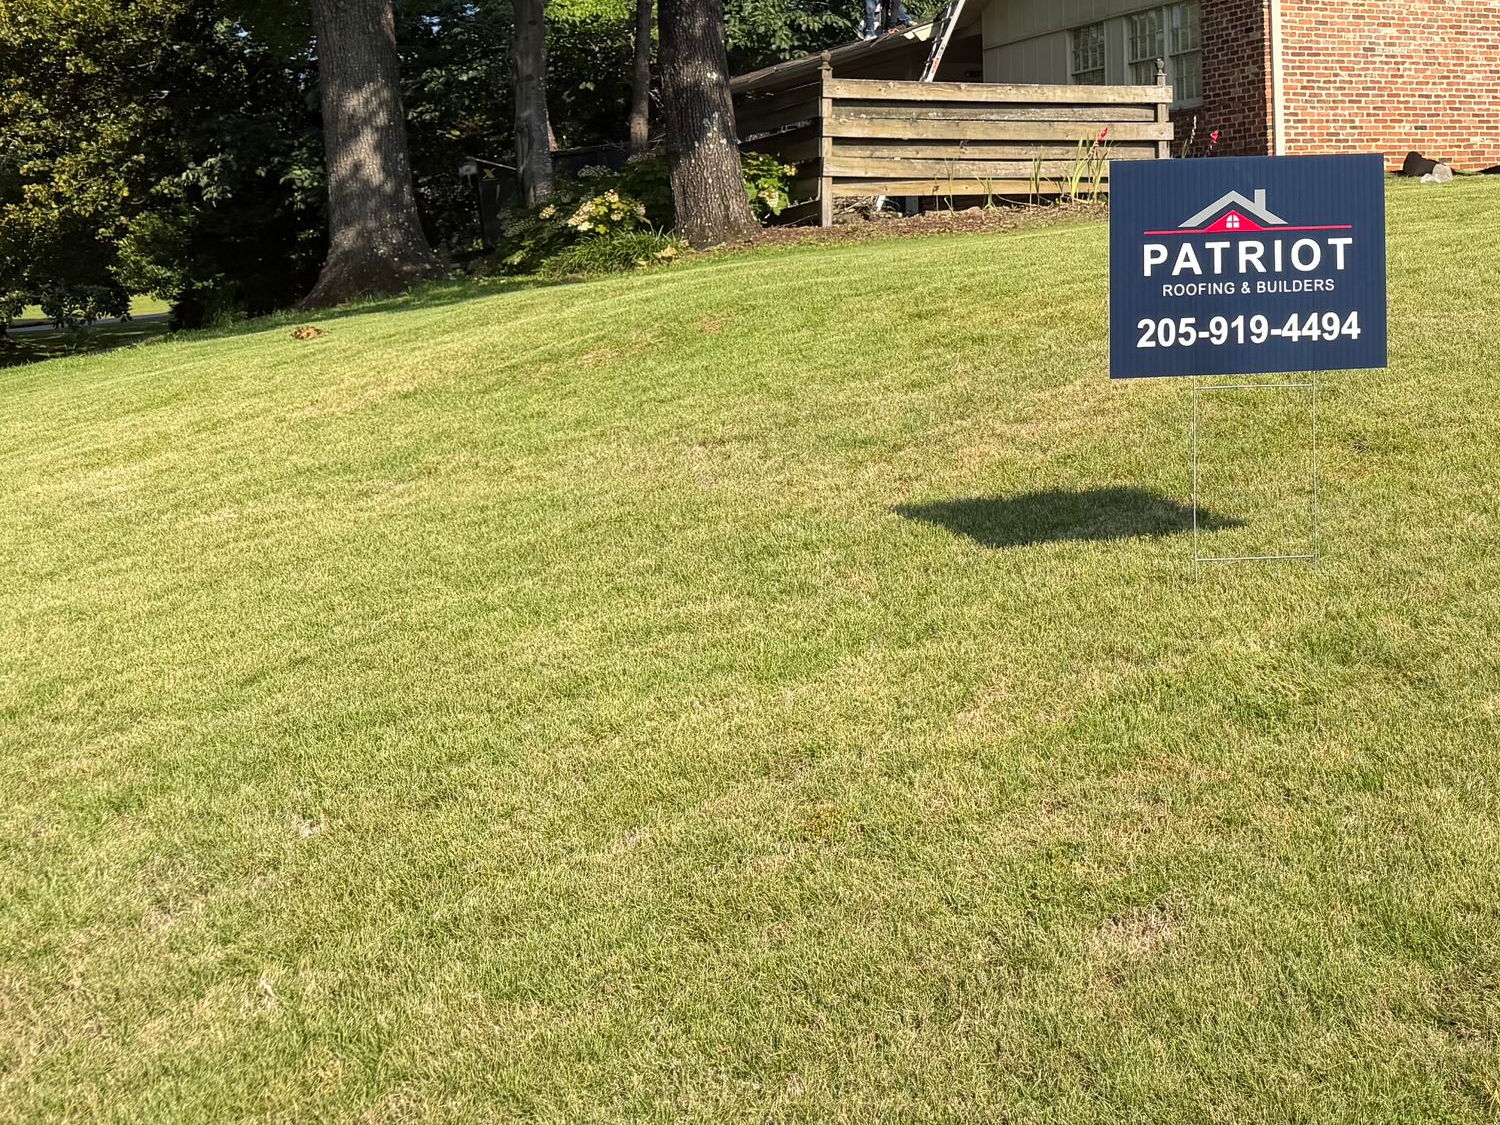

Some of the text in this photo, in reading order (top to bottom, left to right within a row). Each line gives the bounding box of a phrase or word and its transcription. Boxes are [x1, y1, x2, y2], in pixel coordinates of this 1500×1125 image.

[1143, 237, 1353, 277] PATRIOT
[1162, 278, 1335, 297] ROOFING & BUILDERS
[1136, 310, 1361, 348] 205-919-4494
